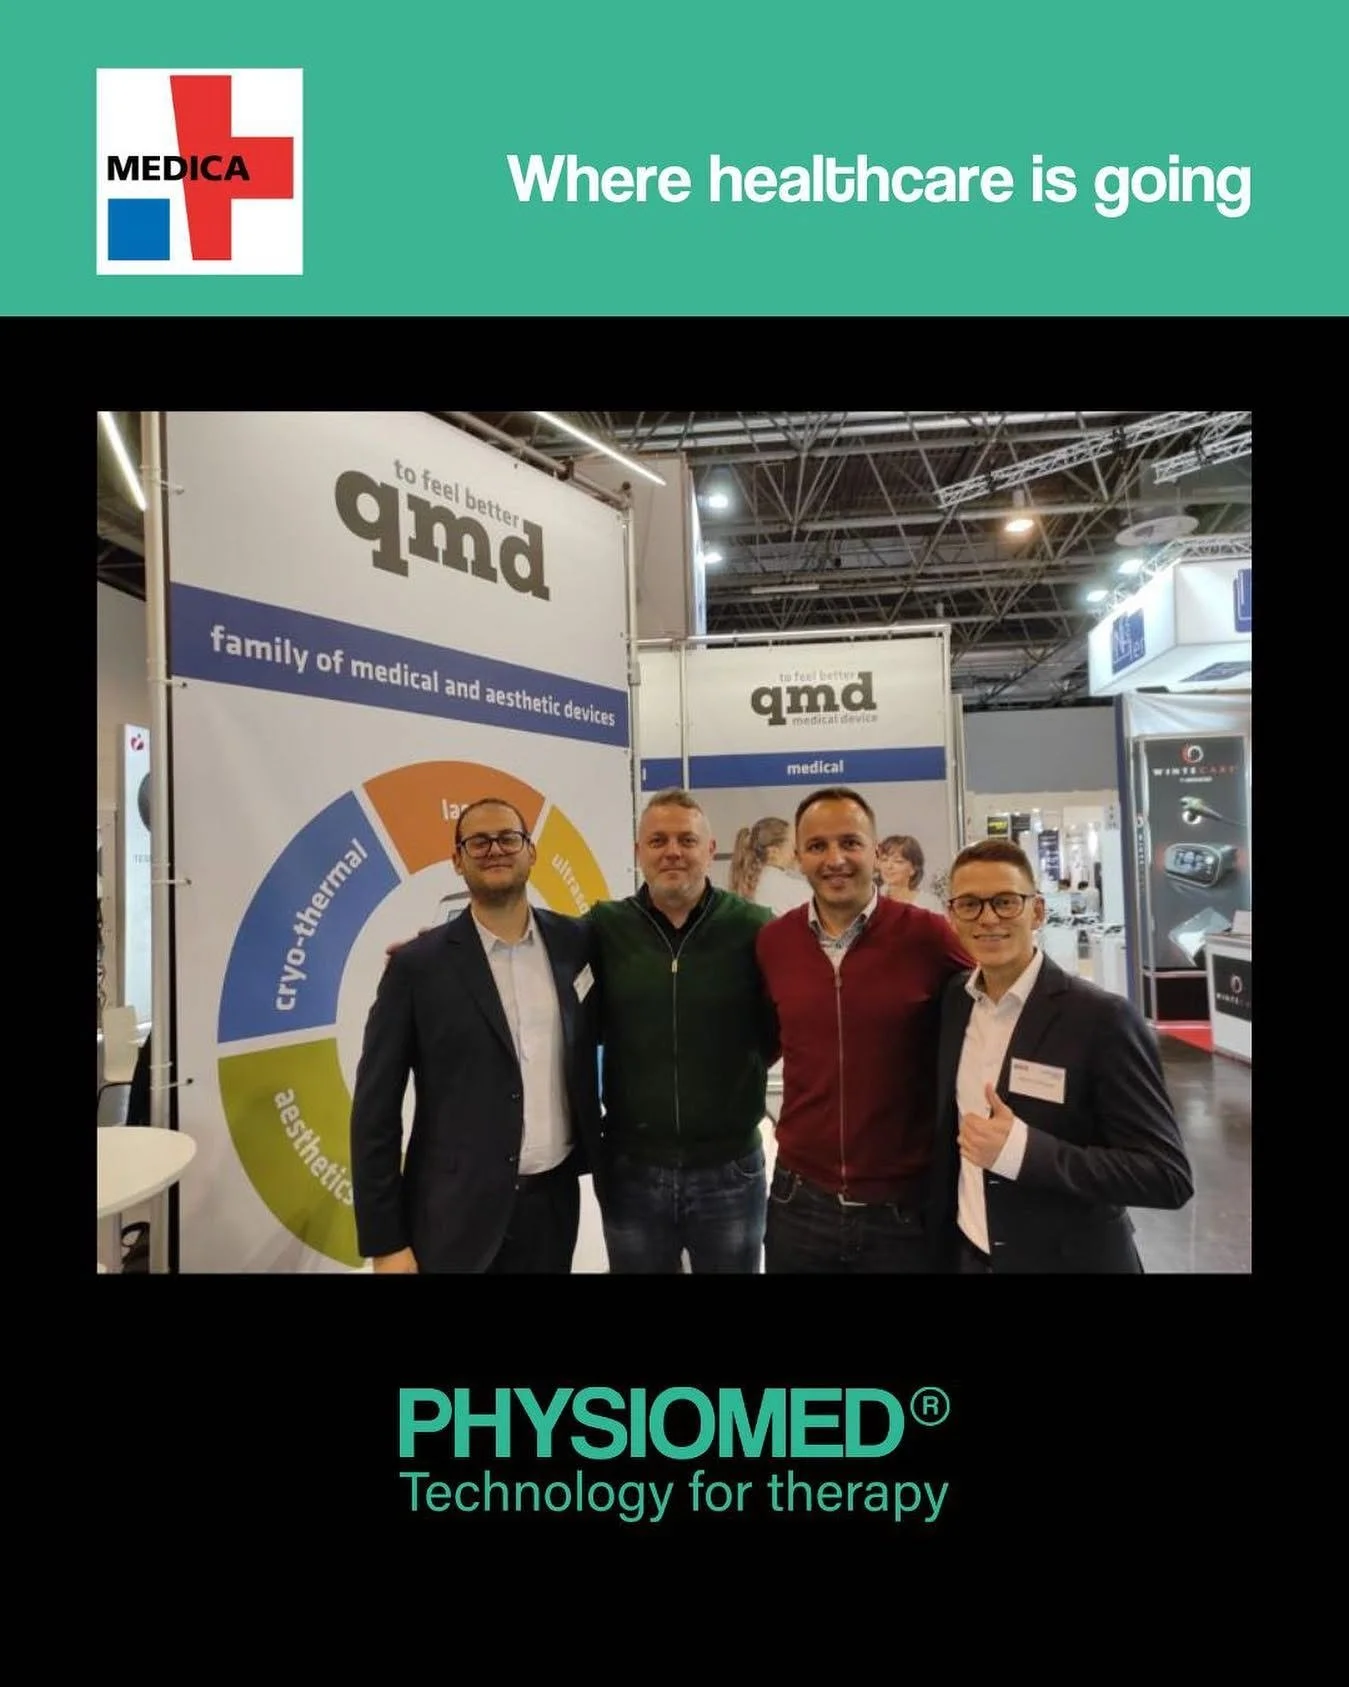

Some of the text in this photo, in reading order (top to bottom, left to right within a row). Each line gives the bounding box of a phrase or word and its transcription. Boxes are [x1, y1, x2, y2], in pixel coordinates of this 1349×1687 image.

[394, 459, 519, 529] to feel better
[335, 470, 550, 601] qmd
[210, 624, 615, 727] family of medical and aesthetic devices
[750, 671, 877, 726] qmd
[792, 713, 838, 727] medical
[786, 759, 845, 777] medical
[275, 836, 369, 1012] cryo-thermal
